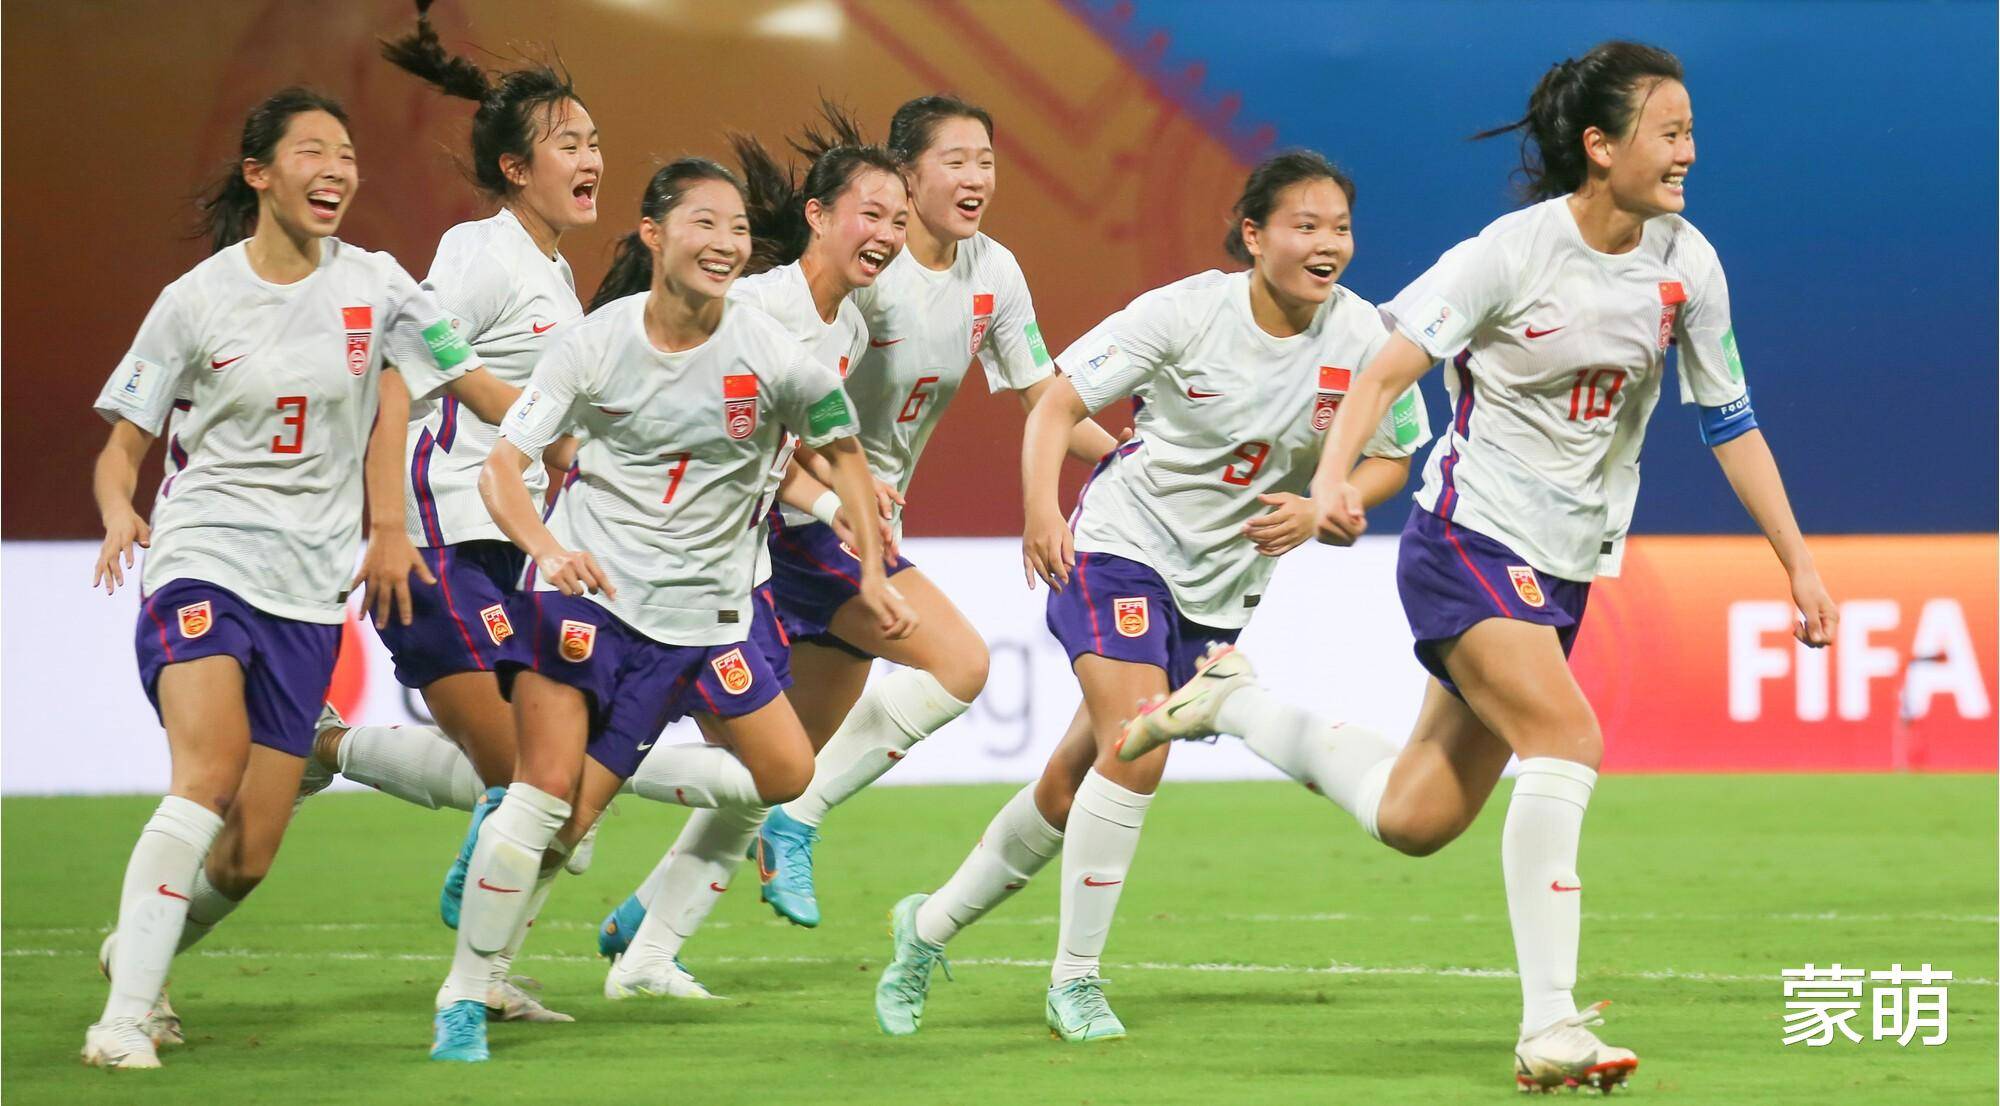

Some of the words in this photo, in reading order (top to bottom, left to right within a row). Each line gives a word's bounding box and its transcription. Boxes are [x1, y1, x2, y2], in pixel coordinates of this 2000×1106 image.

[897, 376, 939, 423] 6
[1567, 368, 1628, 421] 10
[271, 395, 307, 454] 3
[658, 451, 690, 504] 7
[1222, 442, 1271, 486] 9
[1728, 600, 1991, 722] FIFA
